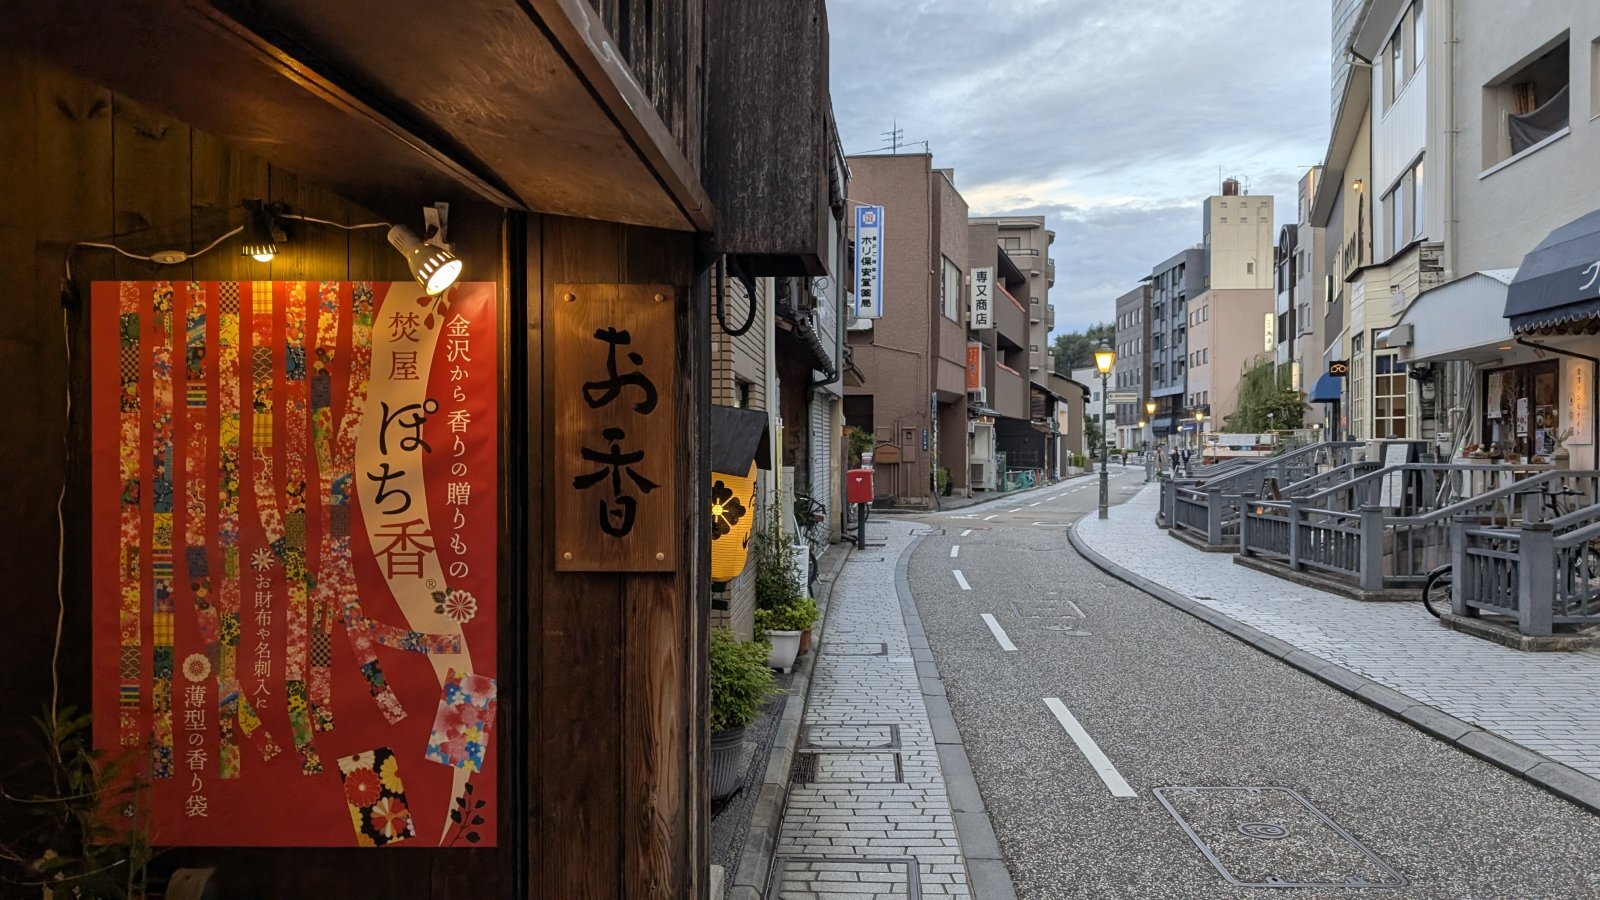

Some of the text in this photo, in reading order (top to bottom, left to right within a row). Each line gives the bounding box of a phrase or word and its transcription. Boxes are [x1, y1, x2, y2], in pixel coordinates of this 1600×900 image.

[860, 236, 872, 308] ホリ保安堂薬局
[976, 271, 988, 325] 専又商店
[366, 311, 439, 580] 焚屋 ぽち香
[446, 313, 472, 579] 金沢から香りの贈りもの
[572, 326, 662, 538] お香
[253, 573, 273, 709] お財布や名刺入に
[184, 685, 208, 817] 薄型の香り袋
